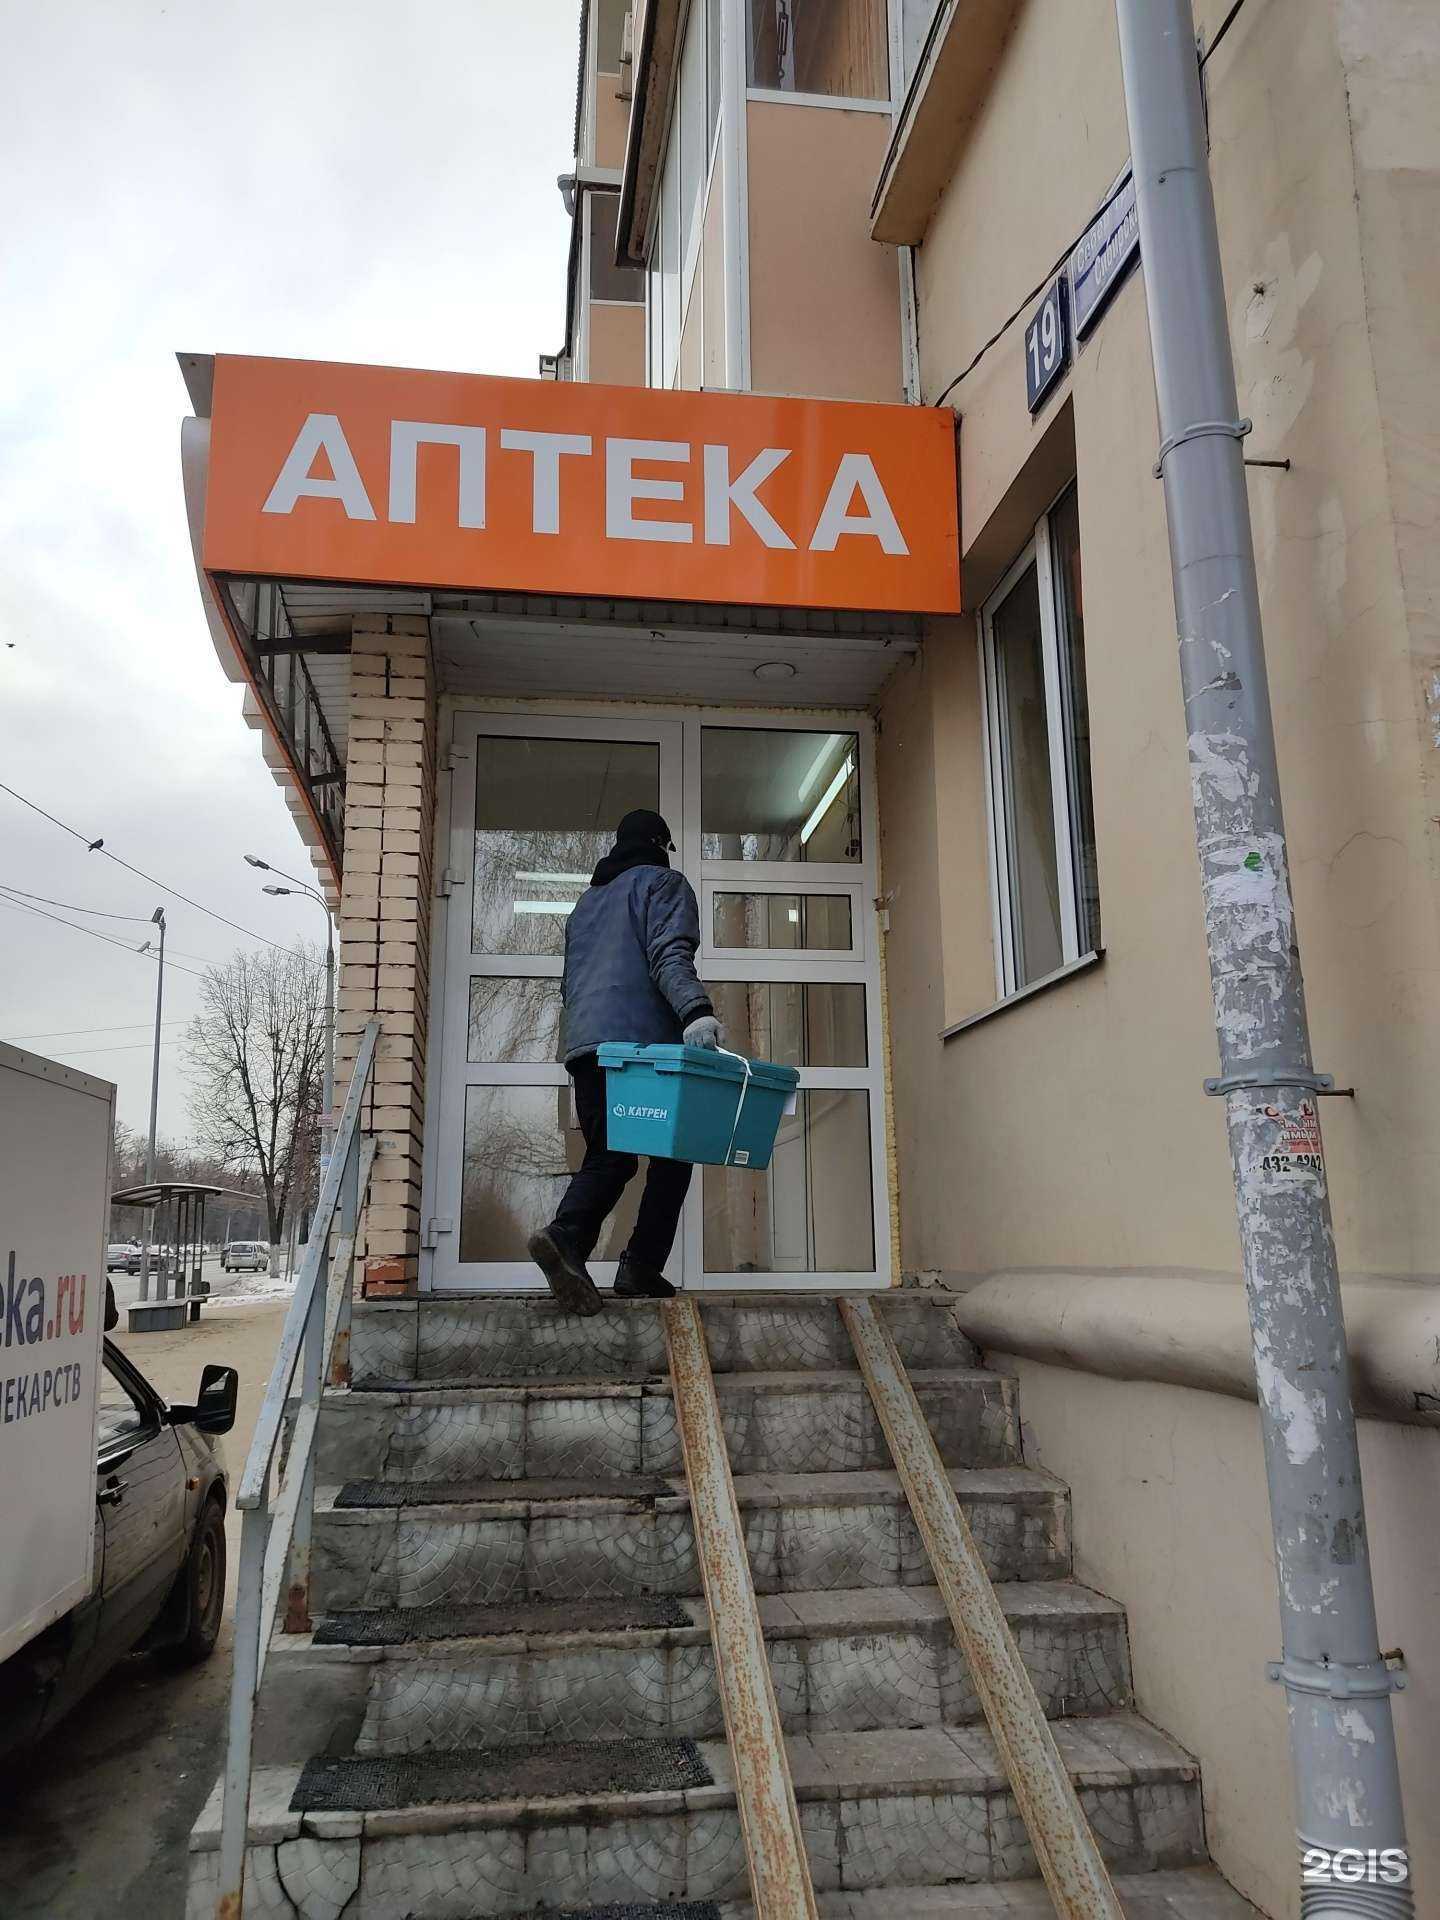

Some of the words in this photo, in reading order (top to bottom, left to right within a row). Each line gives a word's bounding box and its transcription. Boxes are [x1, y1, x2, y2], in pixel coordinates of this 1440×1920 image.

[1029, 300, 1056, 390] 19
[261, 412, 910, 556] АПТЕКА
[627, 1105, 668, 1120] КАТРЕН
[0, 1250, 87, 1348] ka.ru
